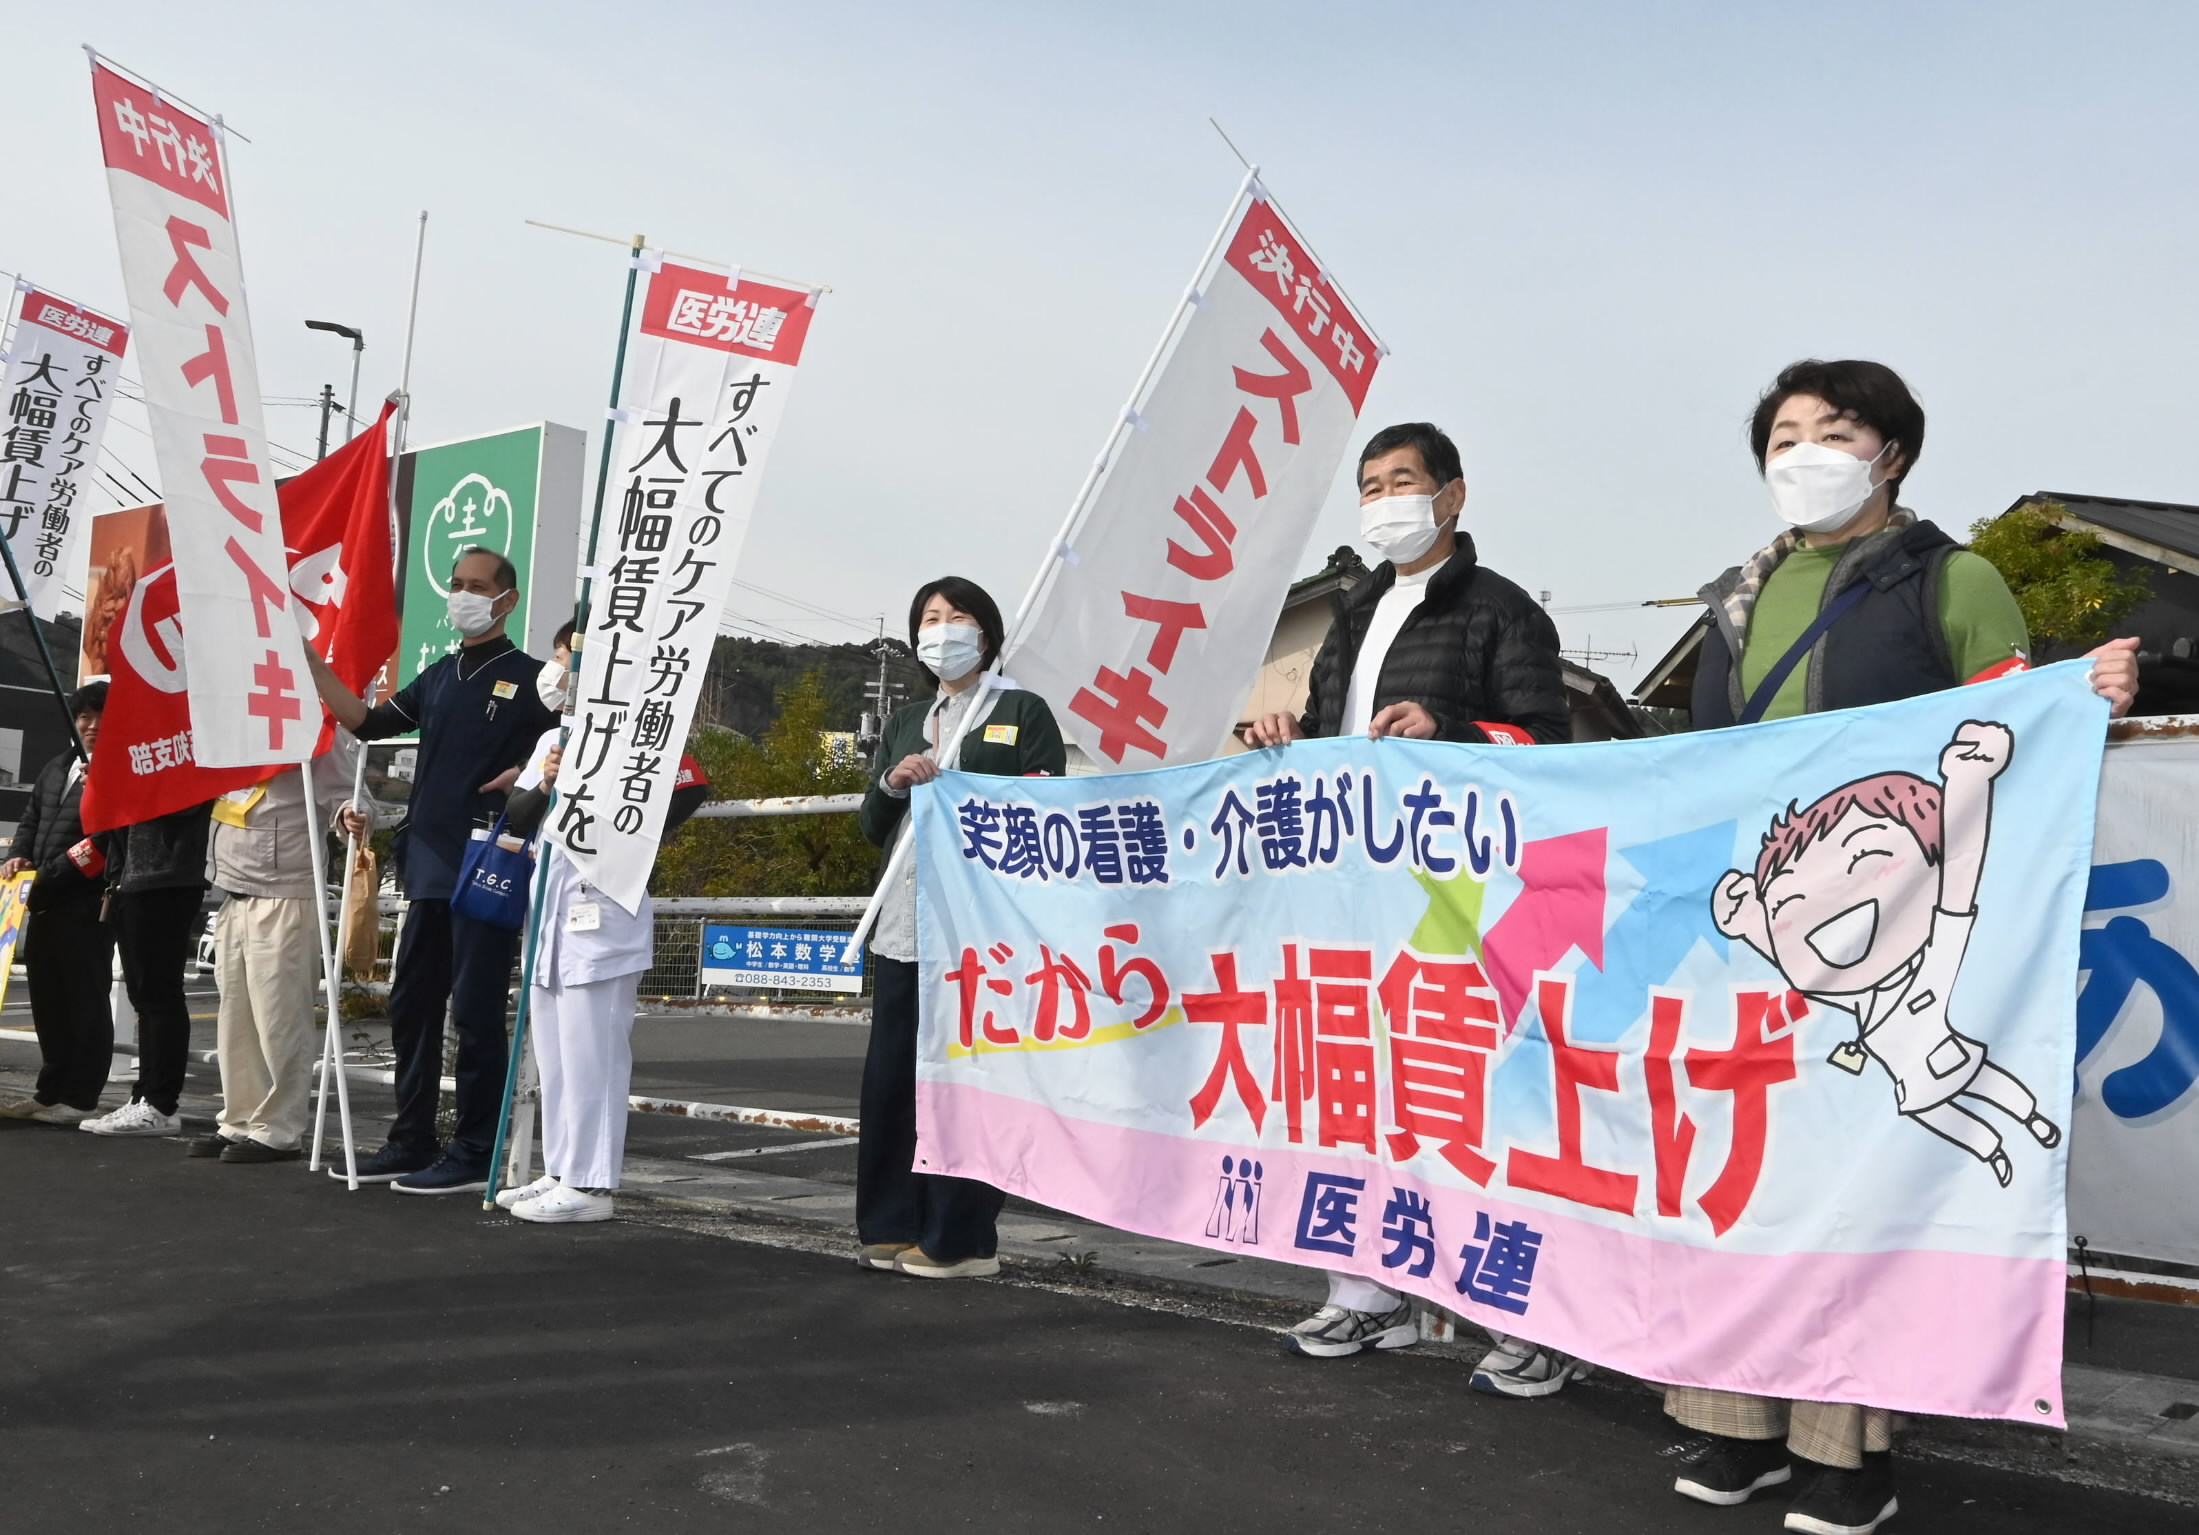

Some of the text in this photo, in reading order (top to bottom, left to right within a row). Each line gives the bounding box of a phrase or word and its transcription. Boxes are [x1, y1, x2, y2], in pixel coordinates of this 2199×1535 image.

[37, 303, 115, 347] 医労連
[666, 287, 788, 353] 医労連
[1247, 229, 1365, 373] 決行中
[33, 353, 111, 578] すべてのケア労働者の
[612, 372, 771, 835] すべてのケア労働者の
[1068, 325, 1313, 765] ストライキ
[556, 397, 703, 856] 大幅賃上げを
[475, 867, 513, 893] T.G.C.
[956, 773, 1517, 885] 笑顔の看護・介護がしたい
[745, 974, 832, 988] 088-843-2353
[944, 923, 1810, 1237] だから 大幅賃上げ
[1294, 1171, 1544, 1316] 医労連
